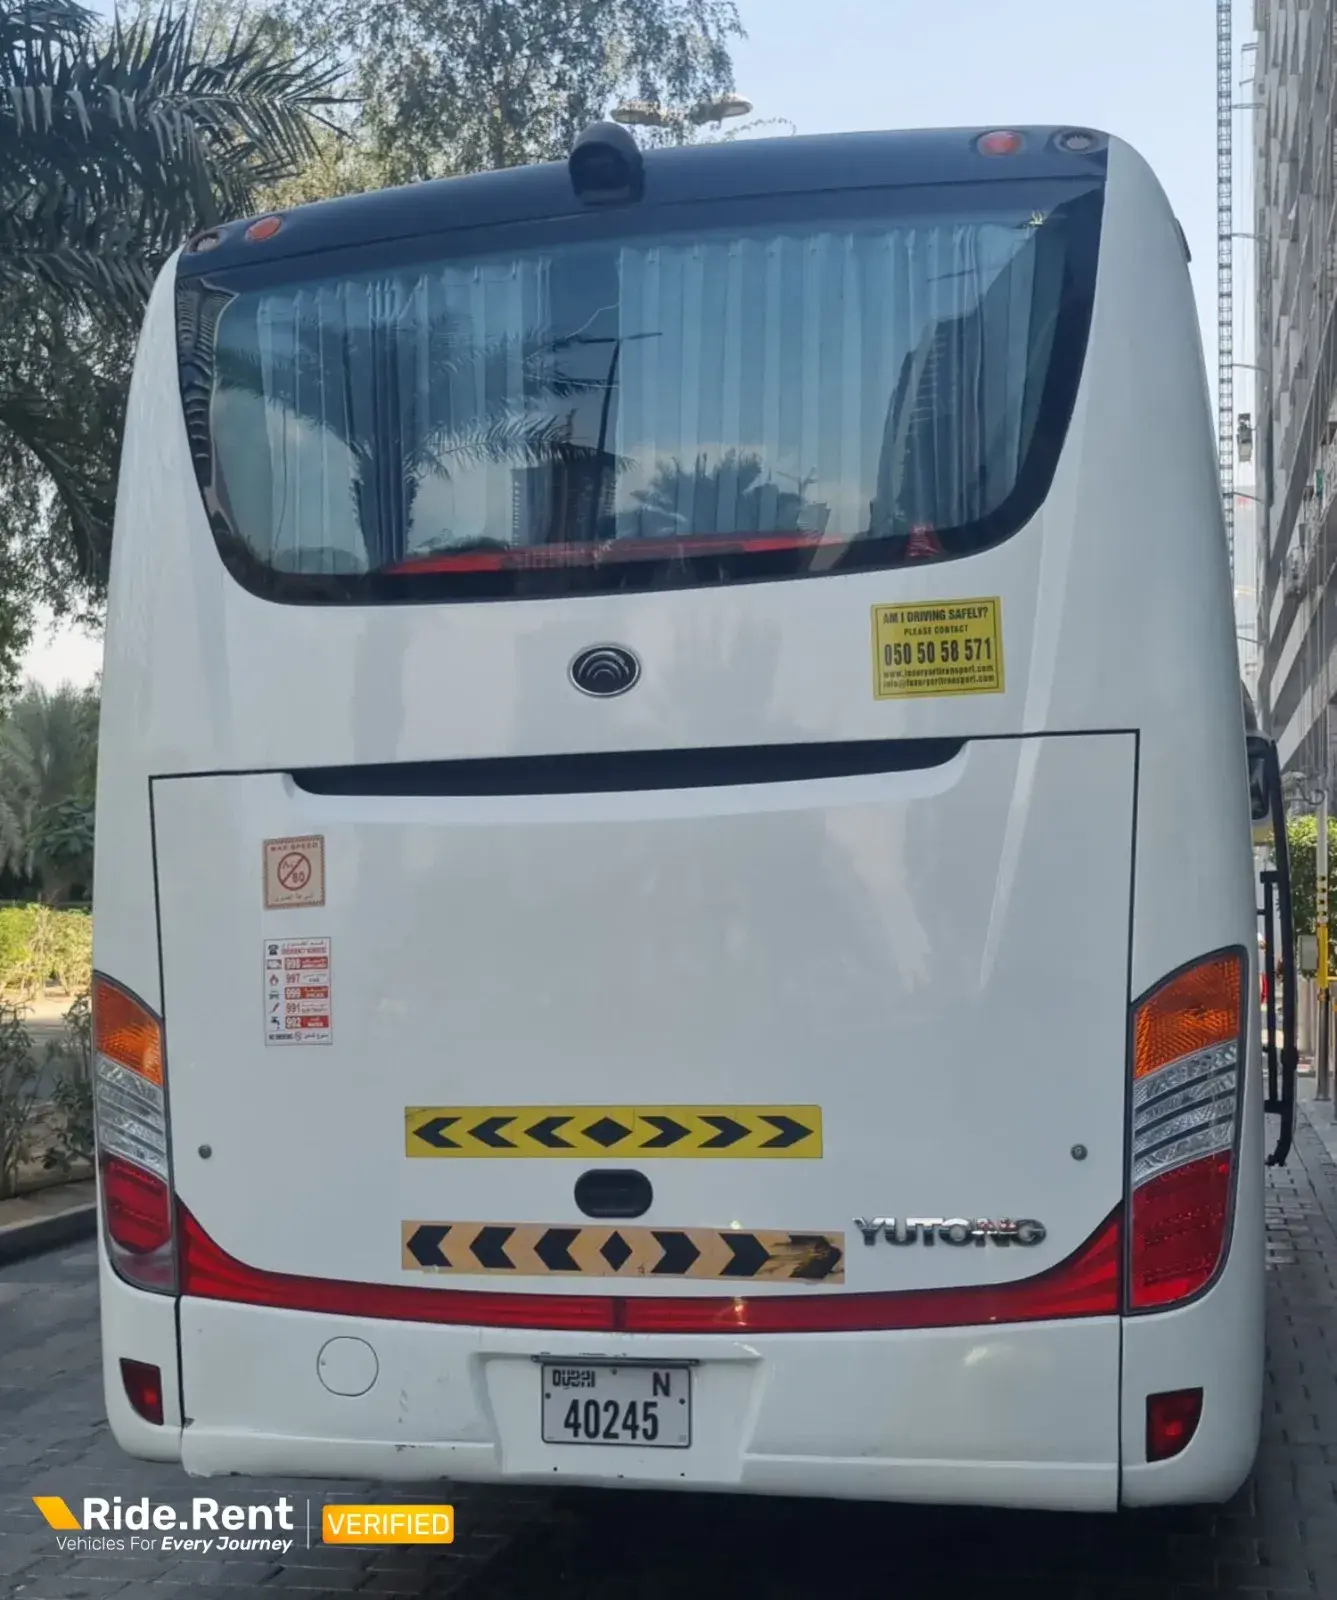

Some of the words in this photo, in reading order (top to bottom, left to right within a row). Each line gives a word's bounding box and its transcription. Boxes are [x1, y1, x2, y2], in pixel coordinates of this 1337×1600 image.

[883, 612, 898, 624] AM
[901, 611, 905, 623] I
[907, 609, 946, 622] DRIVING
[948, 606, 988, 619] SAFELY?
[903, 626, 932, 636] PLEASE
[934, 624, 968, 635] CONTACT
[884, 642, 912, 666] 050
[917, 640, 935, 664] 50
[940, 639, 959, 662] 58
[964, 637, 991, 661] 571
[286, 973, 301, 984] 997
[852, 1216, 1047, 1248] YUTONG
[552, 1368, 596, 1388] DUBAI
[652, 1372, 671, 1397] N
[563, 1399, 659, 1441] 40245
